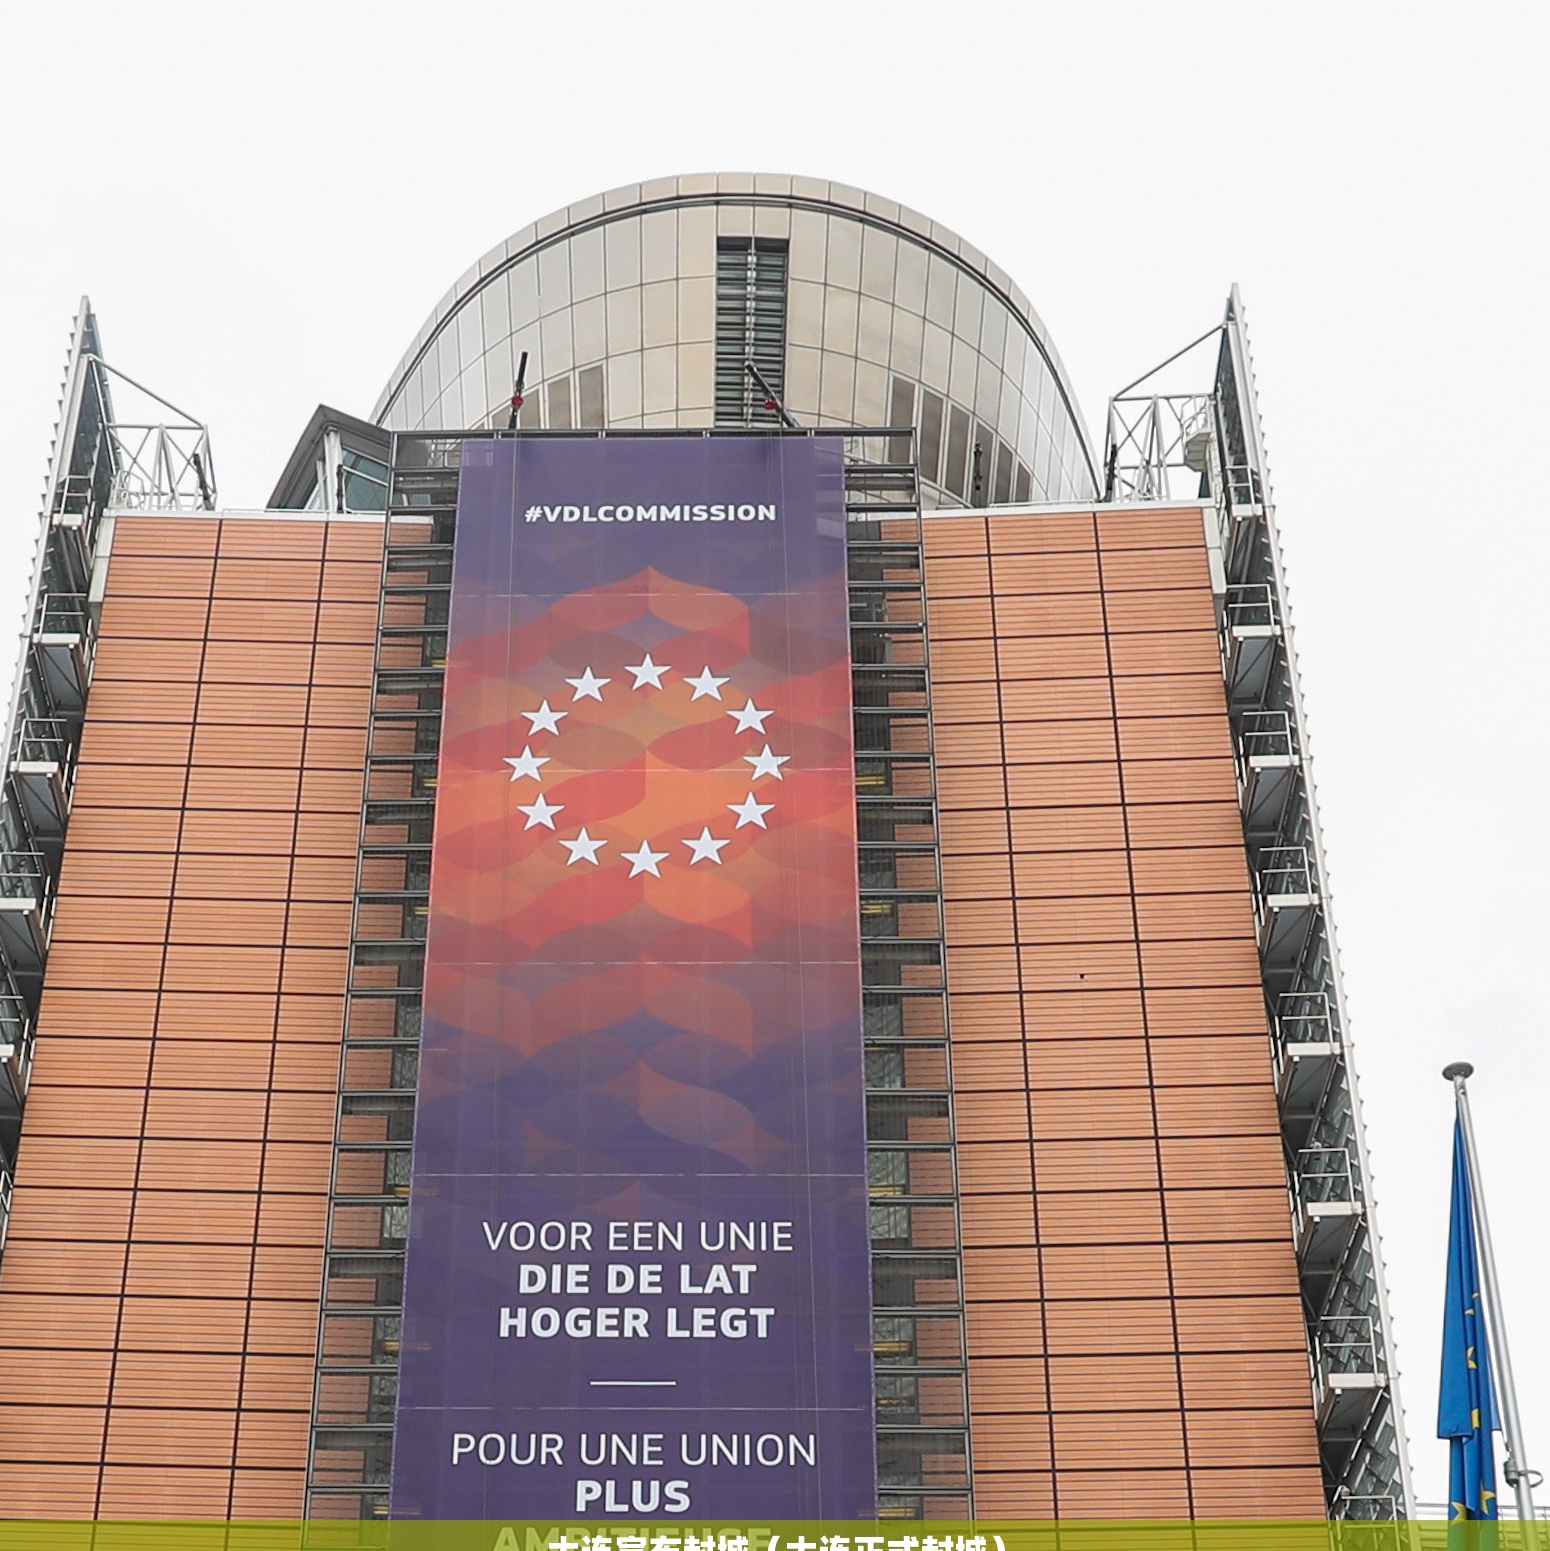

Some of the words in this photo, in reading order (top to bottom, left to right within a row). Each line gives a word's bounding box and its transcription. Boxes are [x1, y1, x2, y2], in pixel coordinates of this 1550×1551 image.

[524, 504, 776, 523] #VDLCOMMISSION
[482, 1221, 592, 1251] VOOR
[608, 1221, 683, 1251] EEN
[700, 1221, 793, 1251] UNIE
[519, 1263, 590, 1294] DIE
[607, 1264, 663, 1294] DE
[680, 1264, 757, 1294] LAT
[499, 1307, 650, 1338] HOGER
[667, 1307, 775, 1338] LEGT
[452, 1433, 564, 1466] POUR
[580, 1433, 664, 1466] UNE
[681, 1433, 817, 1466] UNION
[576, 1480, 691, 1513] PLUS
